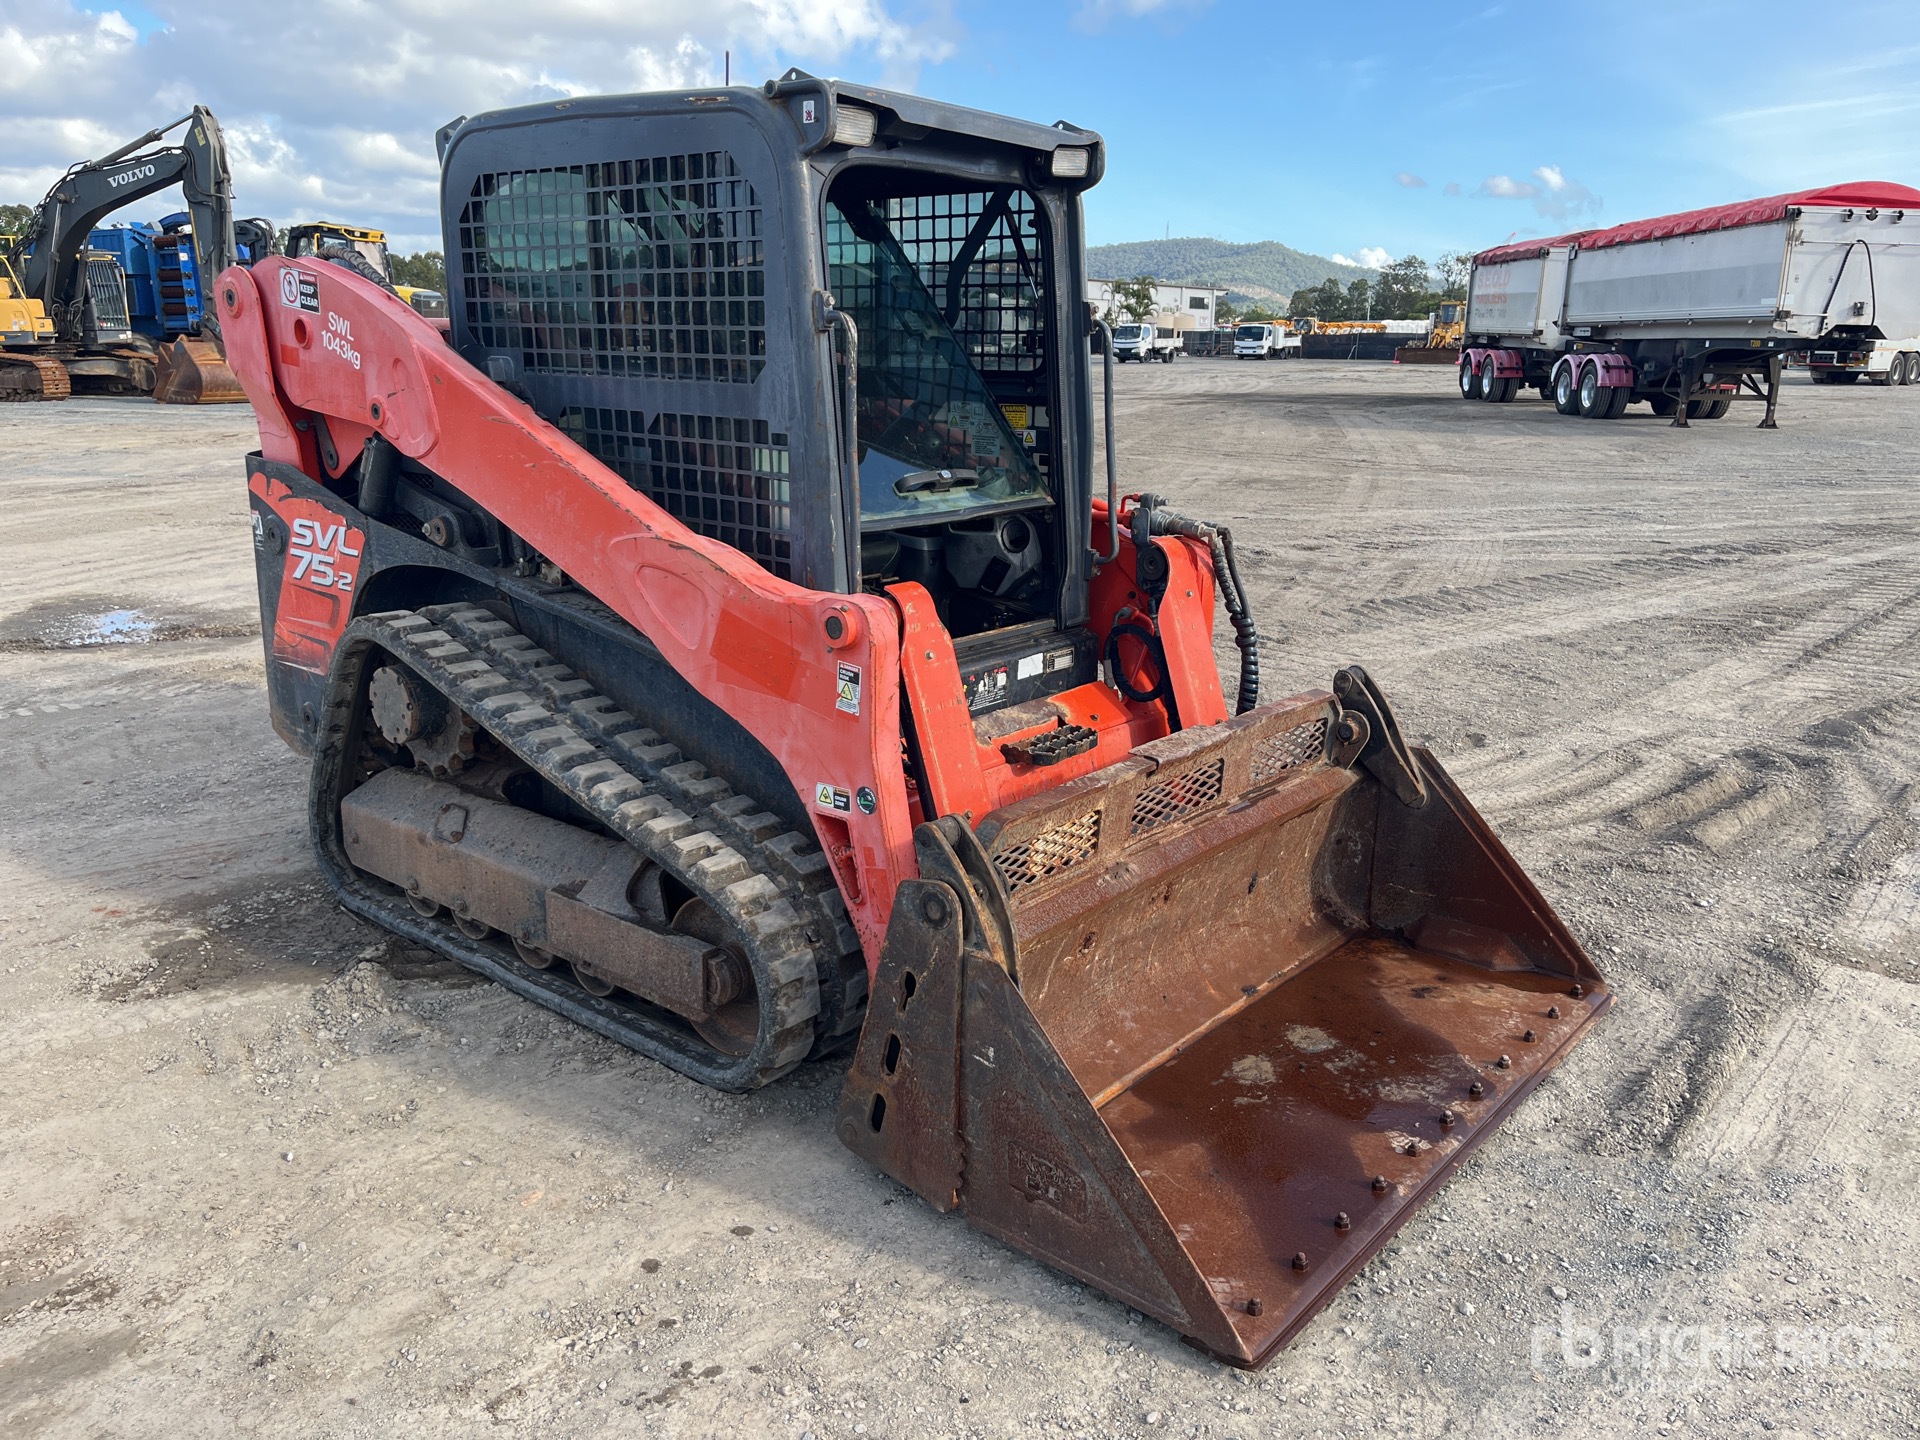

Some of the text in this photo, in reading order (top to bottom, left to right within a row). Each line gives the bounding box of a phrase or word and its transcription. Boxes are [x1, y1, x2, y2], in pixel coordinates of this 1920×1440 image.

[107, 164, 155, 188] VOLVO
[300, 284, 314, 294] KEEP
[301, 296, 318, 307] CLEAR
[328, 311, 354, 342] SWL
[321, 330, 360, 369] 1043kg
[292, 518, 359, 556] SVL
[290, 548, 353, 591] 75-2
